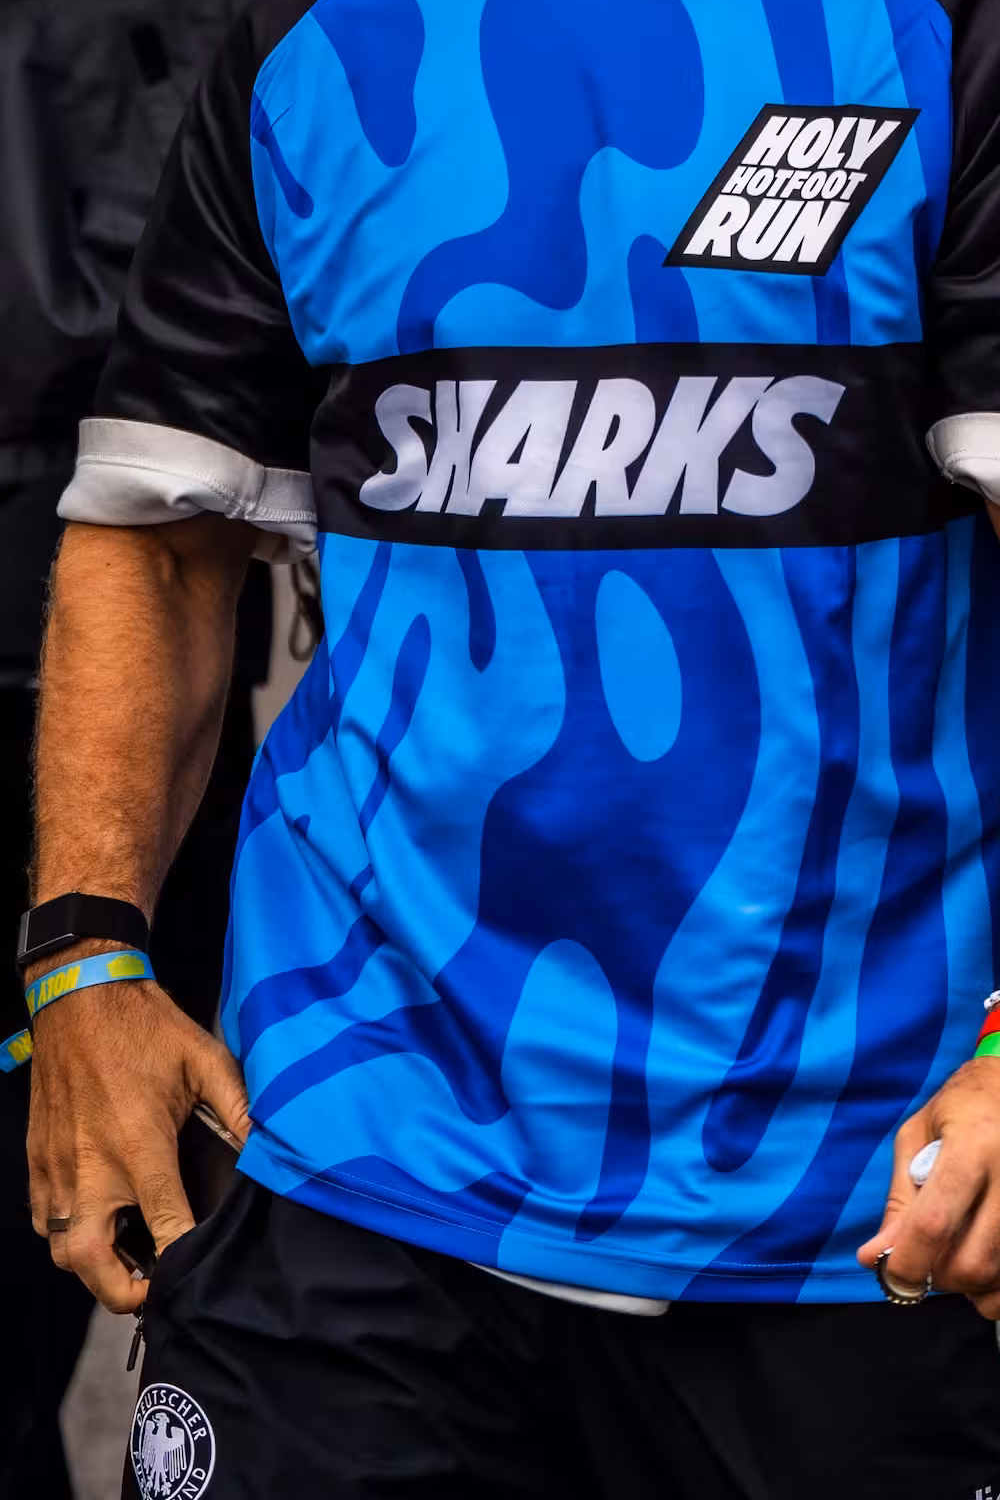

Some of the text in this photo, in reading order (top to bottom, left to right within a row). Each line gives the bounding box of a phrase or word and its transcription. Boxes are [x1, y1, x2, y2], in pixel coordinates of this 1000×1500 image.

[742, 115, 901, 170] HOLY
[721, 165, 868, 200] HOTFOOT
[683, 194, 850, 263] RUN
[359, 375, 846, 518] SHARKS
[137, 1389, 207, 1440] DEUTSCHER
